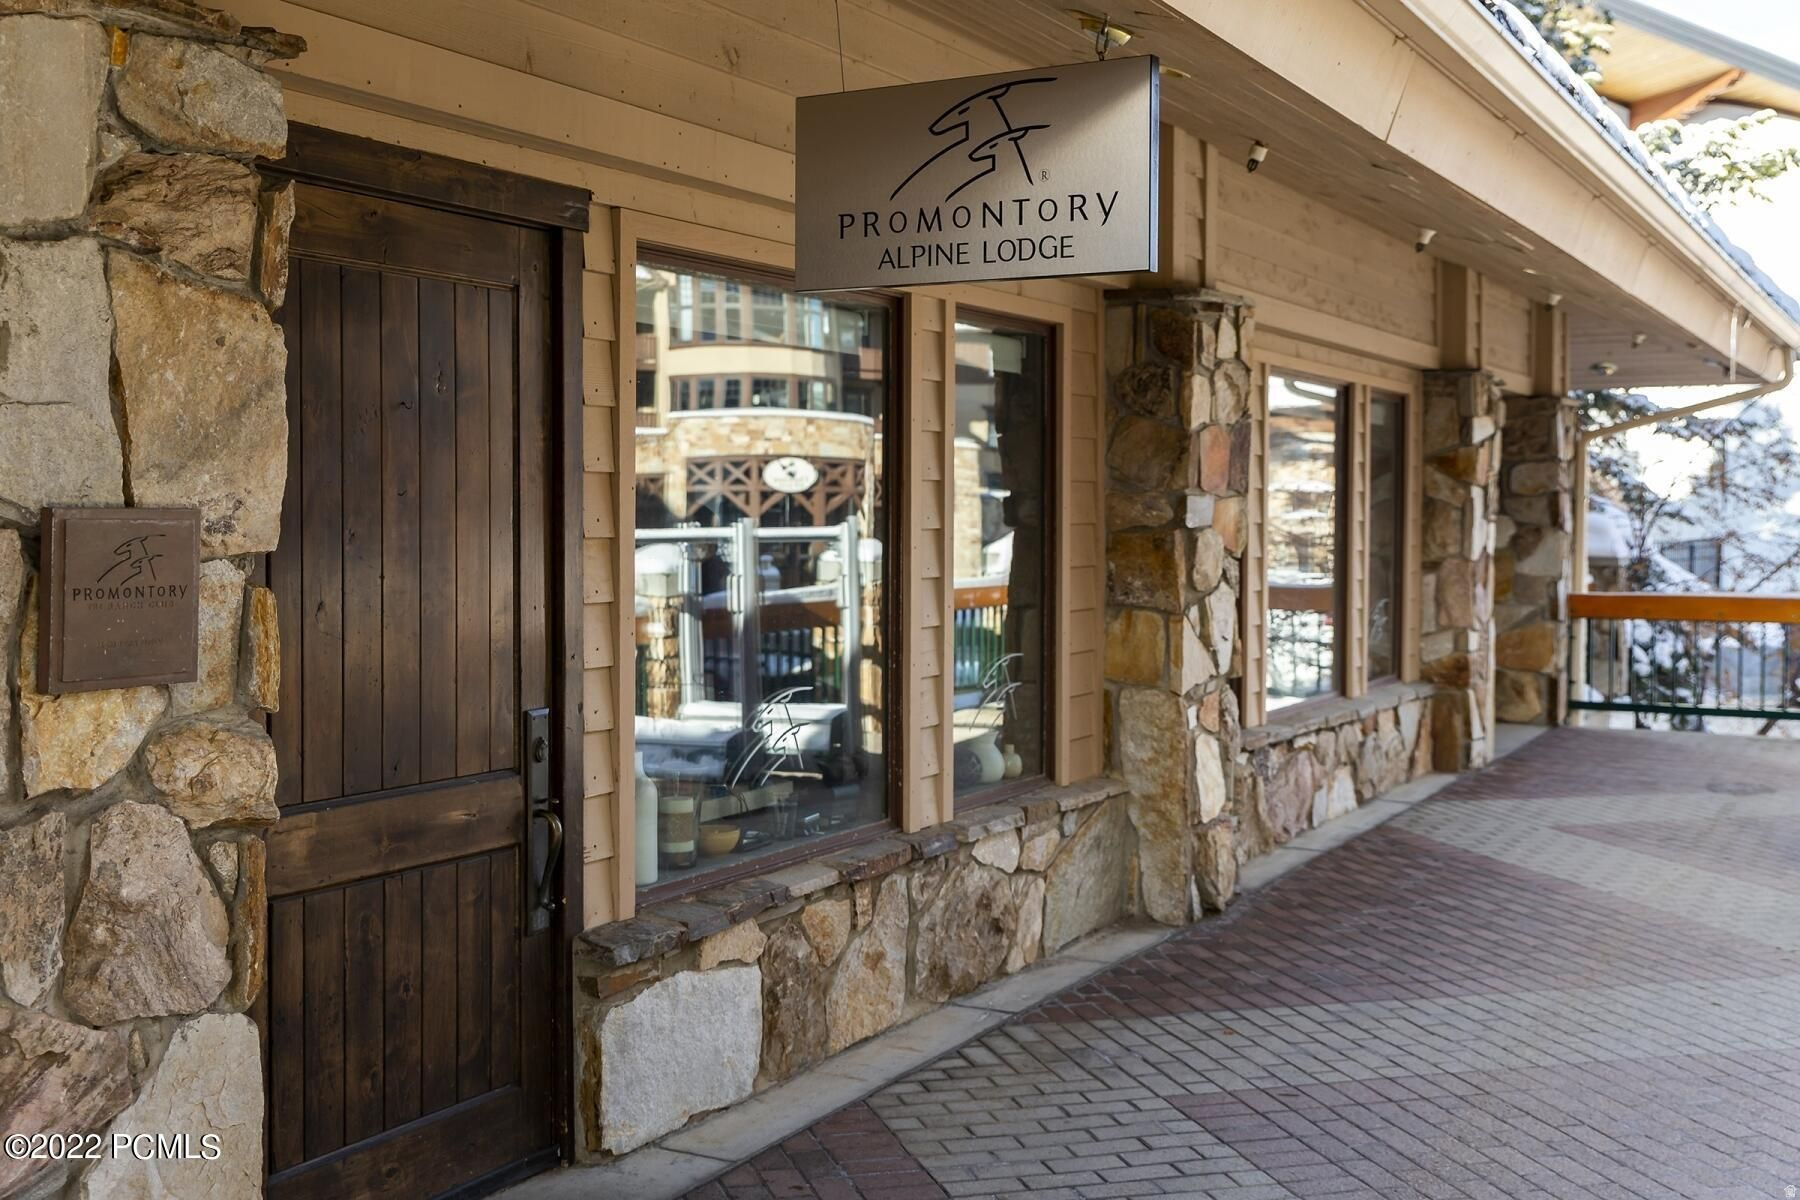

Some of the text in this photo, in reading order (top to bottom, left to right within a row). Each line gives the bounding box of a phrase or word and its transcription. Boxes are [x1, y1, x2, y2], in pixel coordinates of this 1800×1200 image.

[838, 190, 1119, 240] PROMONTORY
[878, 235, 1075, 270] ALPINE LODGE
[72, 584, 188, 601] PROMONTORY
